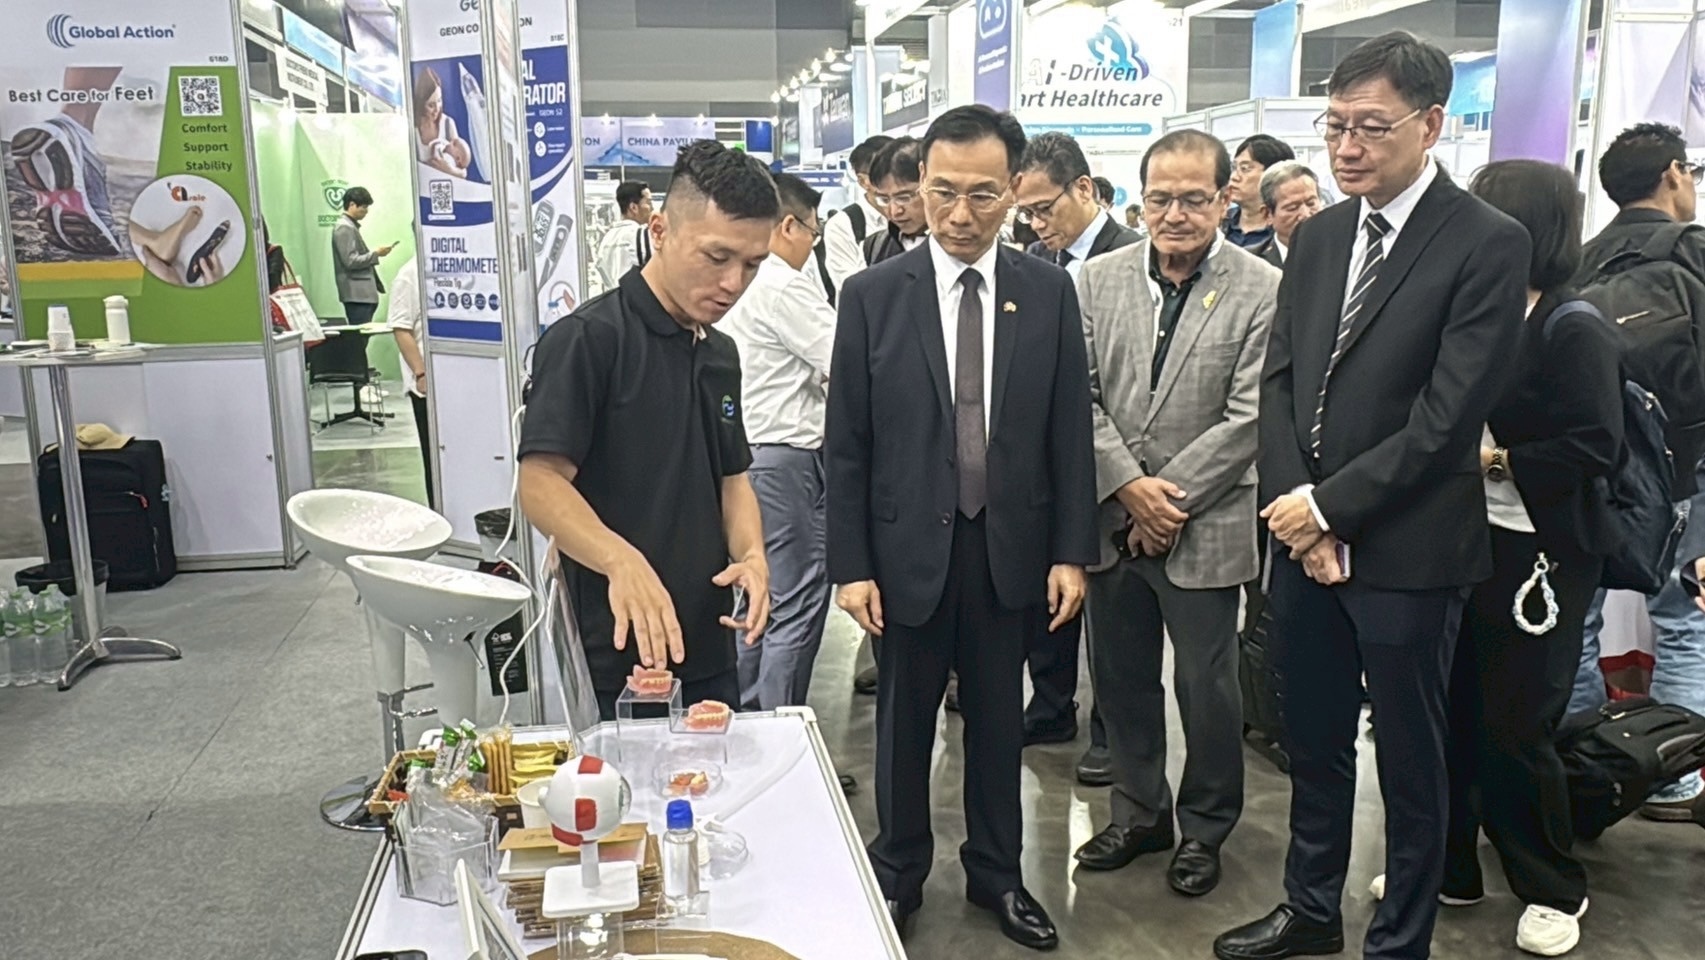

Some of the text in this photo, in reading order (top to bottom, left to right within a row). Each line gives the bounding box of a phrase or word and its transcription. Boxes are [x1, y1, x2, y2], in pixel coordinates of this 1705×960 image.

[69, 25, 174, 39] Global Action
[440, 25, 464, 37] GEON
[8, 86, 154, 102] Best Care for Feet
[1050, 88, 1163, 107] Healthcare
[182, 123, 228, 133] Comfort
[183, 142, 229, 153] Support
[628, 137, 660, 146] CHINA
[185, 160, 232, 172] Stability
[431, 237, 468, 253] DIGITAL
[431, 257, 498, 274] THERMOMETE
